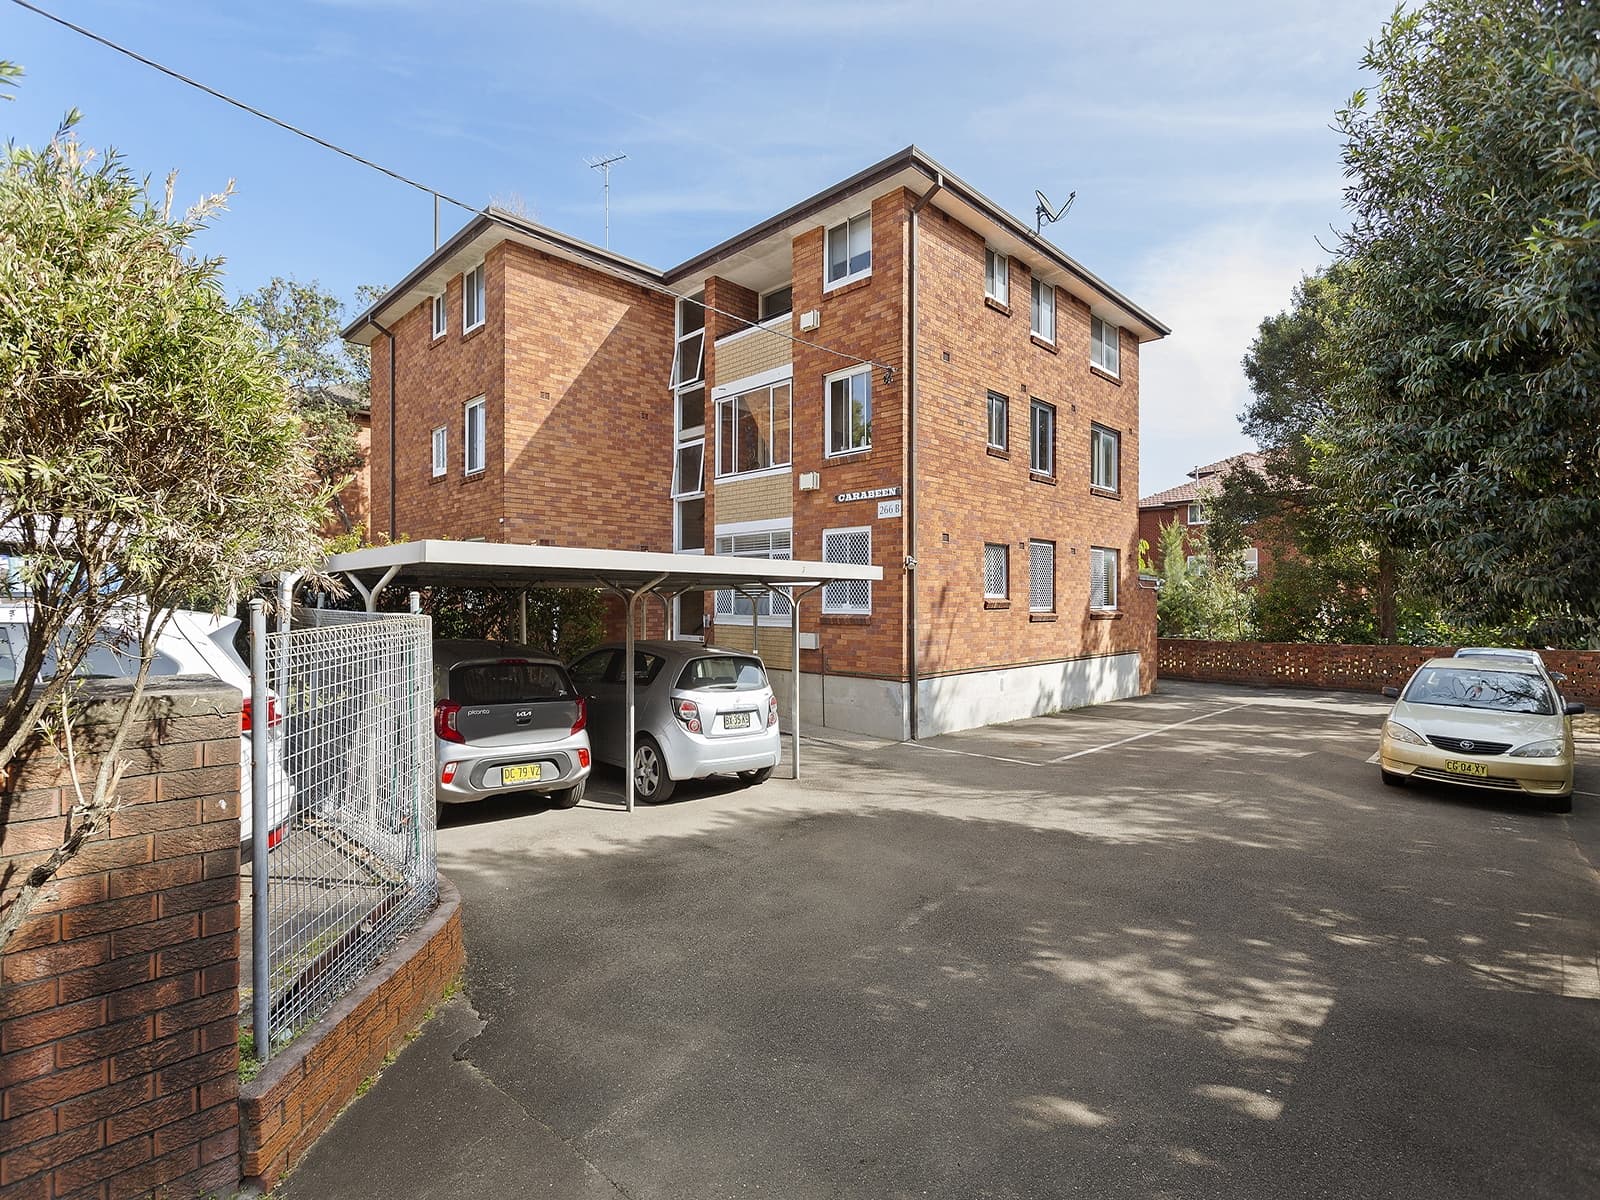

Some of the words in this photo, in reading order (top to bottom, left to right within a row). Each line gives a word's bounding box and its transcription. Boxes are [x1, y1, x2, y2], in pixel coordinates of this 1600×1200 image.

[838, 487, 897, 502] CARABEEN
[880, 504, 894, 515] 266
[895, 503, 900, 514] B
[504, 768, 516, 780] DC
[517, 767, 528, 778] 79
[1460, 763, 1472, 772] 04
[1475, 763, 1486, 775] XY
